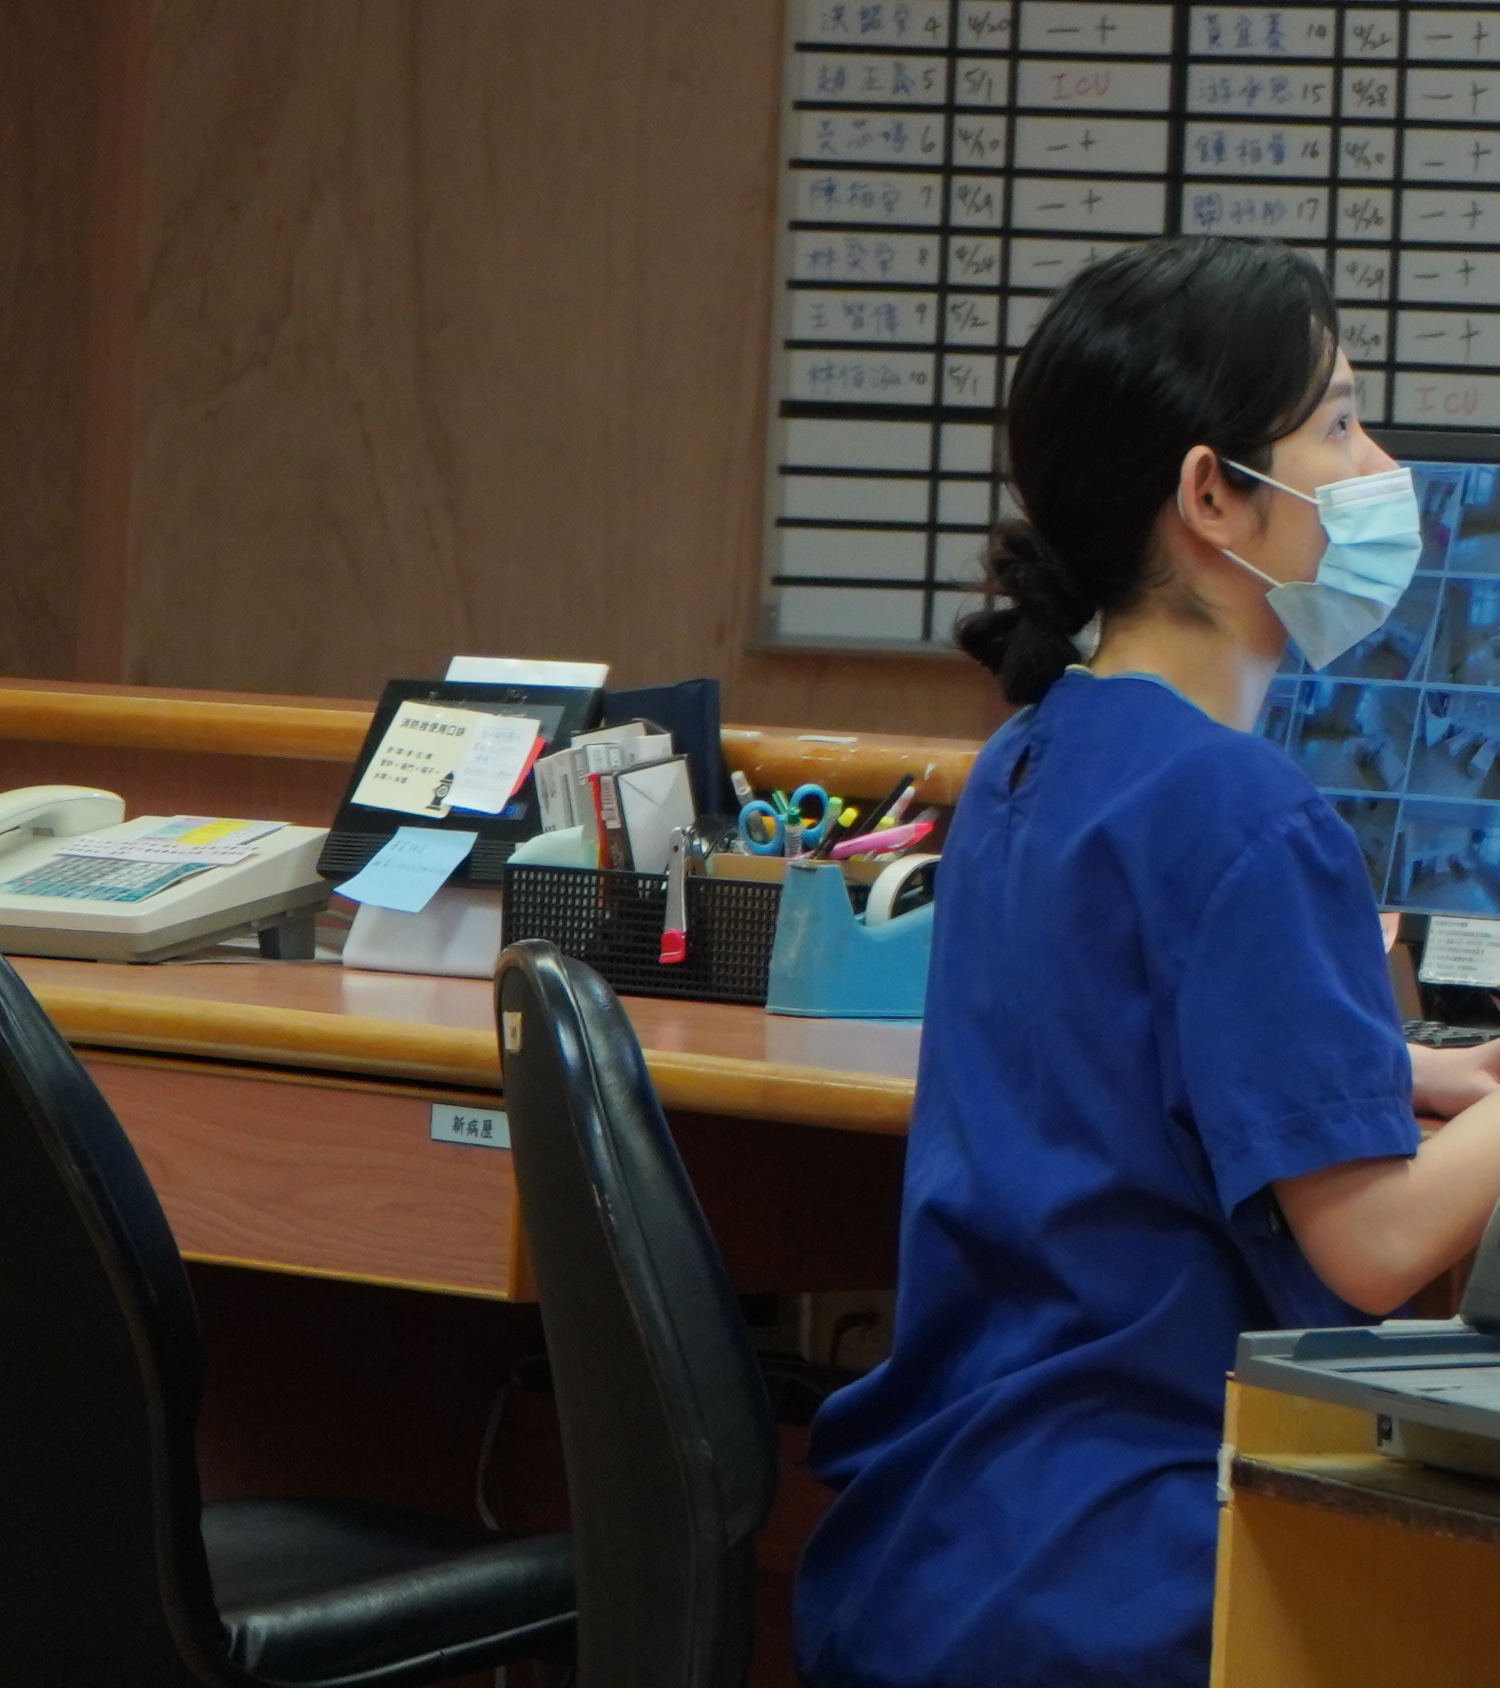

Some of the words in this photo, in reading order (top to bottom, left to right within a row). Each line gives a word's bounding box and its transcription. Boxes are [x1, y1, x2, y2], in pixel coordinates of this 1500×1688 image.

[1301, 82, 1325, 102] 15
[920, 126, 936, 155] 6
[1297, 198, 1318, 224] 17
